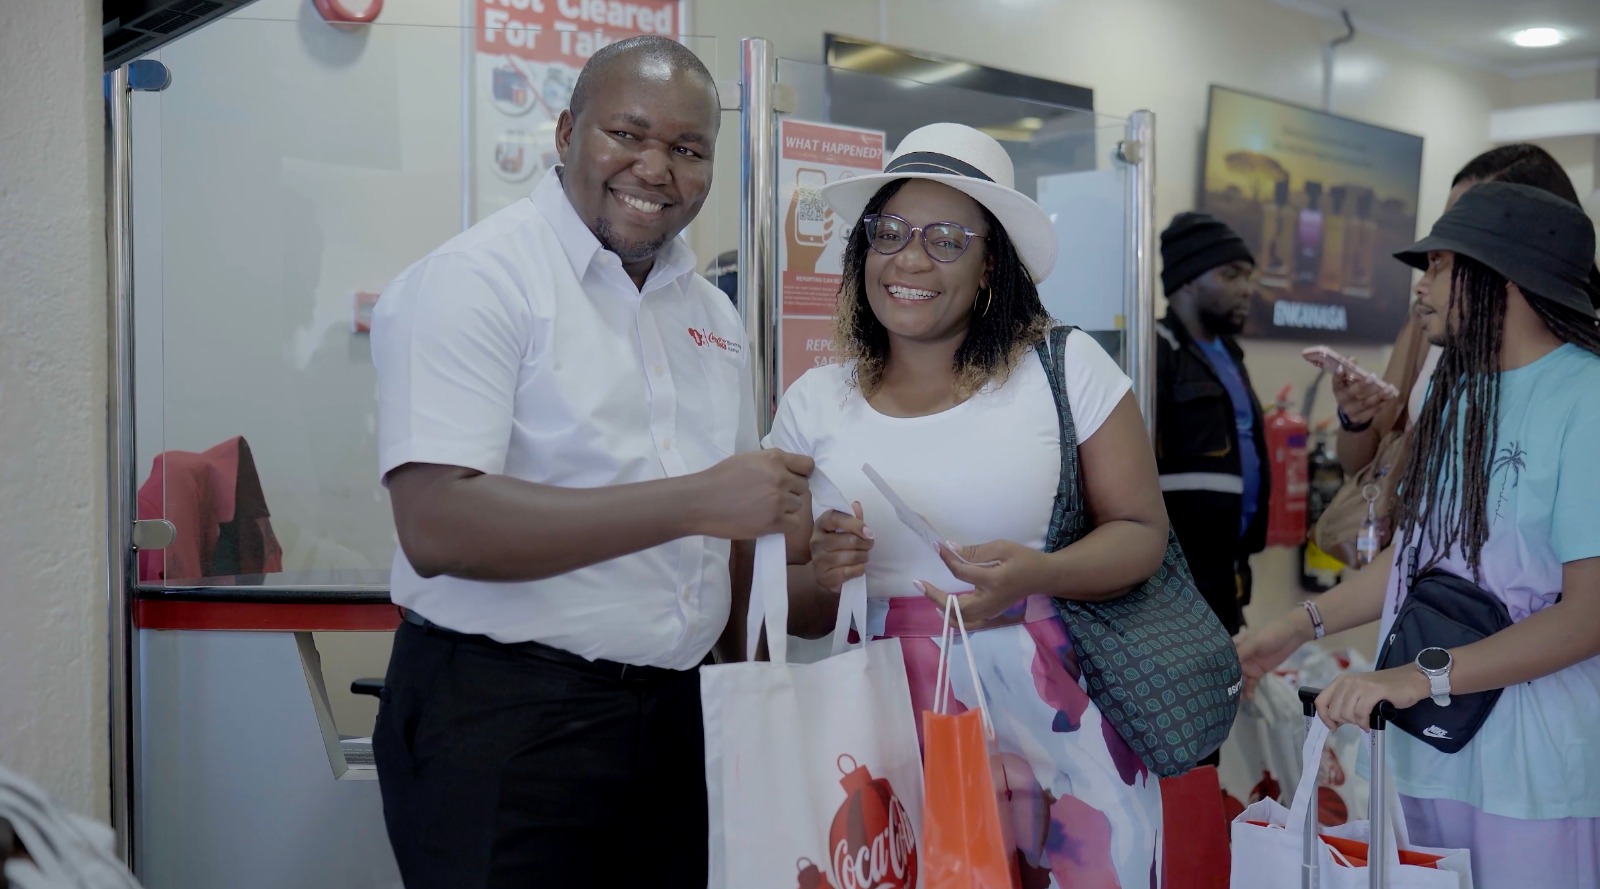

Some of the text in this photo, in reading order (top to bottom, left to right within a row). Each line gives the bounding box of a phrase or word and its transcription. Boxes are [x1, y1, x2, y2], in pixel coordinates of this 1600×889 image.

[485, 8, 542, 49] For
[786, 136, 882, 159] WHAT HAPPENED?
[1428, 725, 1448, 736] NIKE
